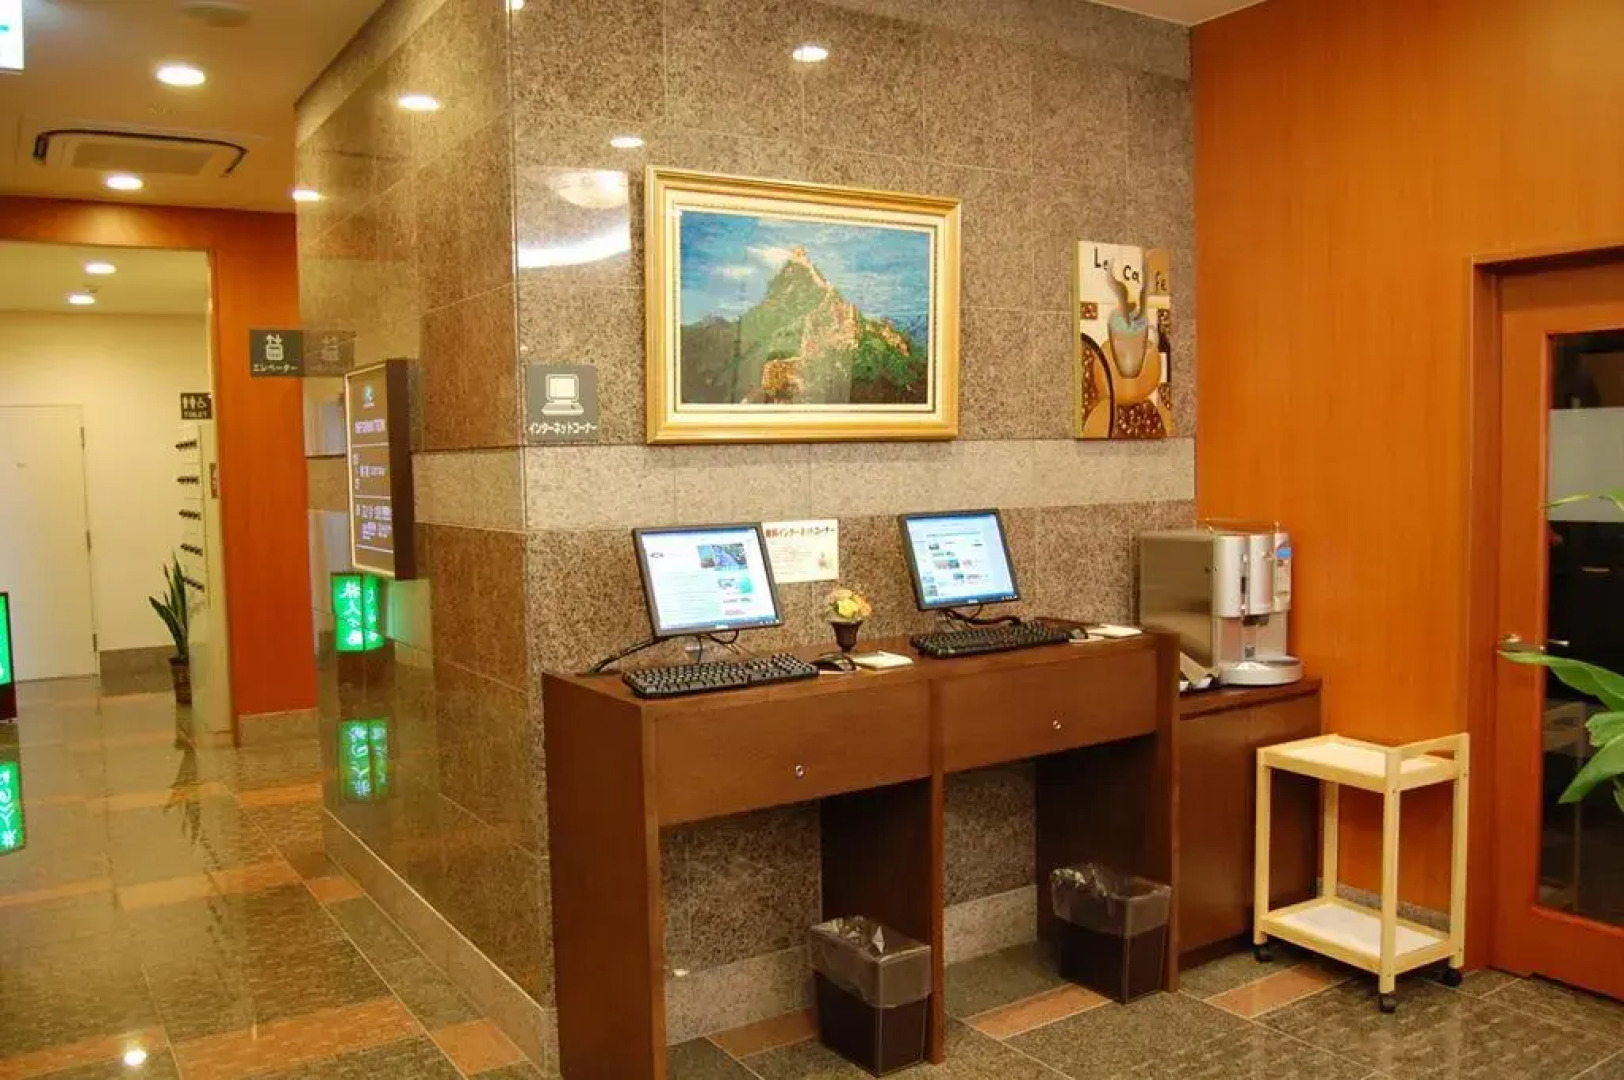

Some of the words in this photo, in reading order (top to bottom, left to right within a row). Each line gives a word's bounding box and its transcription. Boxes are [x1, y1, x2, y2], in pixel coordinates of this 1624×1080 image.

[1094, 246, 1108, 271] Le
[253, 363, 299, 373] エレベーター
[528, 421, 598, 435] インターネットコーナー
